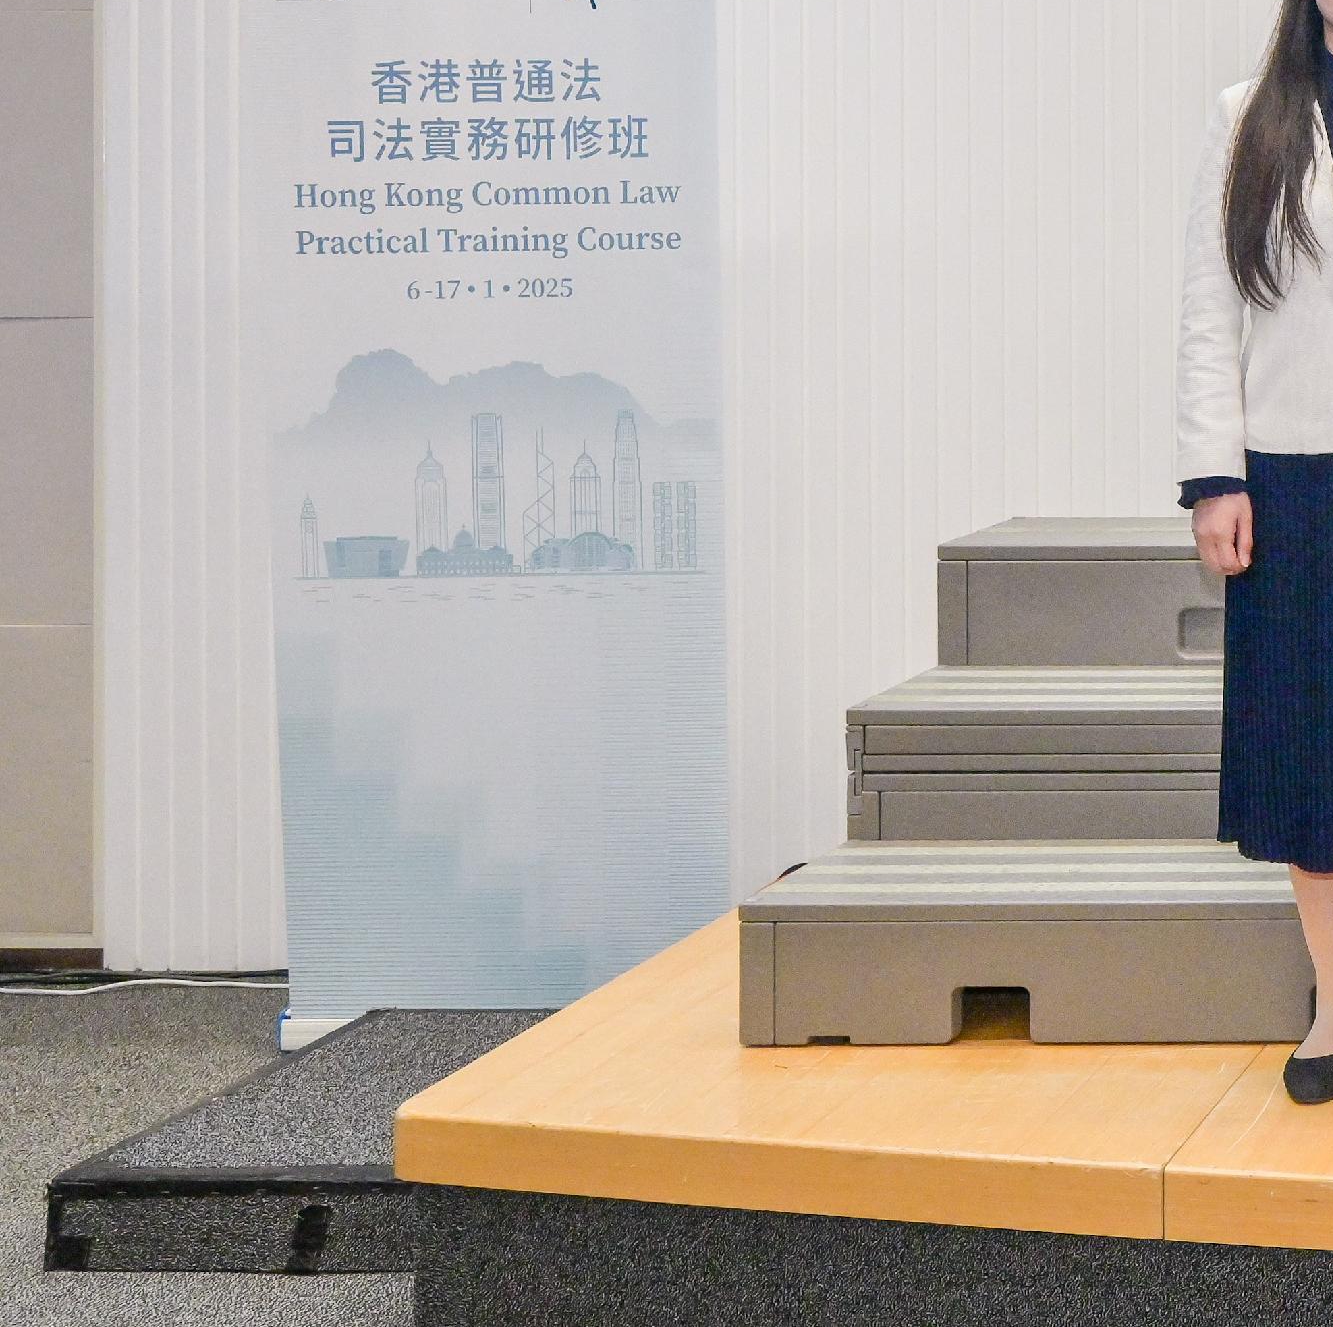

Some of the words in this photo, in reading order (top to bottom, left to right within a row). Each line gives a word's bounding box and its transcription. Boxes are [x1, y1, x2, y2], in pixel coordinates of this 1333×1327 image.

[371, 58, 601, 104] 香港普通法
[327, 115, 648, 162] 司法實務研修班
[294, 184, 376, 214] Hong
[385, 183, 463, 214] Kong
[472, 181, 610, 206] Common
[620, 180, 681, 204] Law
[296, 227, 429, 254] Practical
[437, 226, 568, 259] Training
[578, 227, 681, 251] Course
